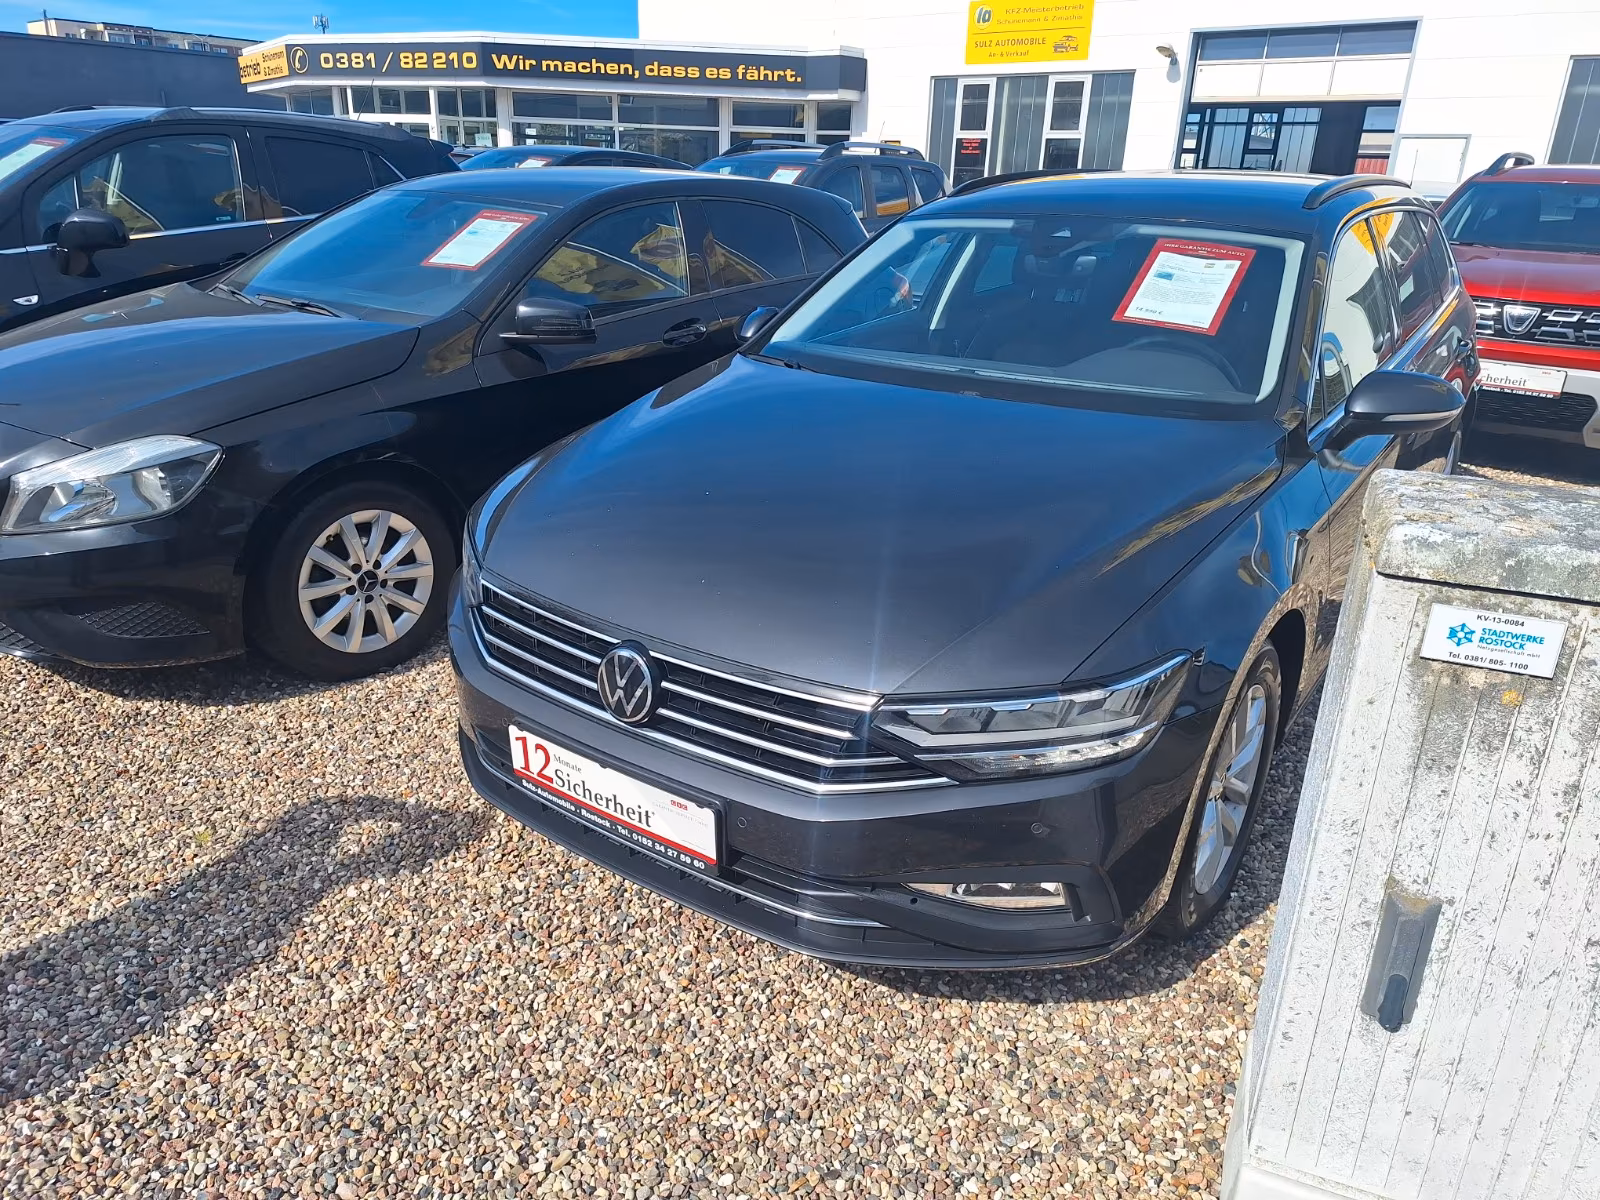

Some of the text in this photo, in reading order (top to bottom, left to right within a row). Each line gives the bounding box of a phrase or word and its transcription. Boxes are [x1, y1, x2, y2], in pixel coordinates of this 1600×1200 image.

[1005, 4, 1085, 15] KFZ-Meisterbetrieb
[974, 37, 1047, 49] SULZ AUTOMOBILE
[319, 52, 377, 69] 0381
[399, 52, 429, 69] 82
[432, 52, 478, 69] 210
[1005, 50, 1030, 58] Verkauf
[491, 53, 803, 83] Wir machen, dass es fährt.
[1480, 373, 1528, 387] cherheit
[1476, 614, 1525, 628] KV-13-0084
[1478, 636, 1527, 651] ROSTOCK
[1481, 627, 1546, 645] STADTWERKE
[1447, 651, 1529, 671] Tel. 0381/ 805- 1100
[514, 736, 554, 785] 12
[553, 753, 583, 774] Monate
[554, 768, 653, 828] Sicherheit
[521, 778, 576, 812] Sulz-Automobile
[580, 808, 611, 829] Rostock
[616, 824, 631, 838] Tel.
[654, 843, 666, 853] 34
[666, 848, 678, 858] 27
